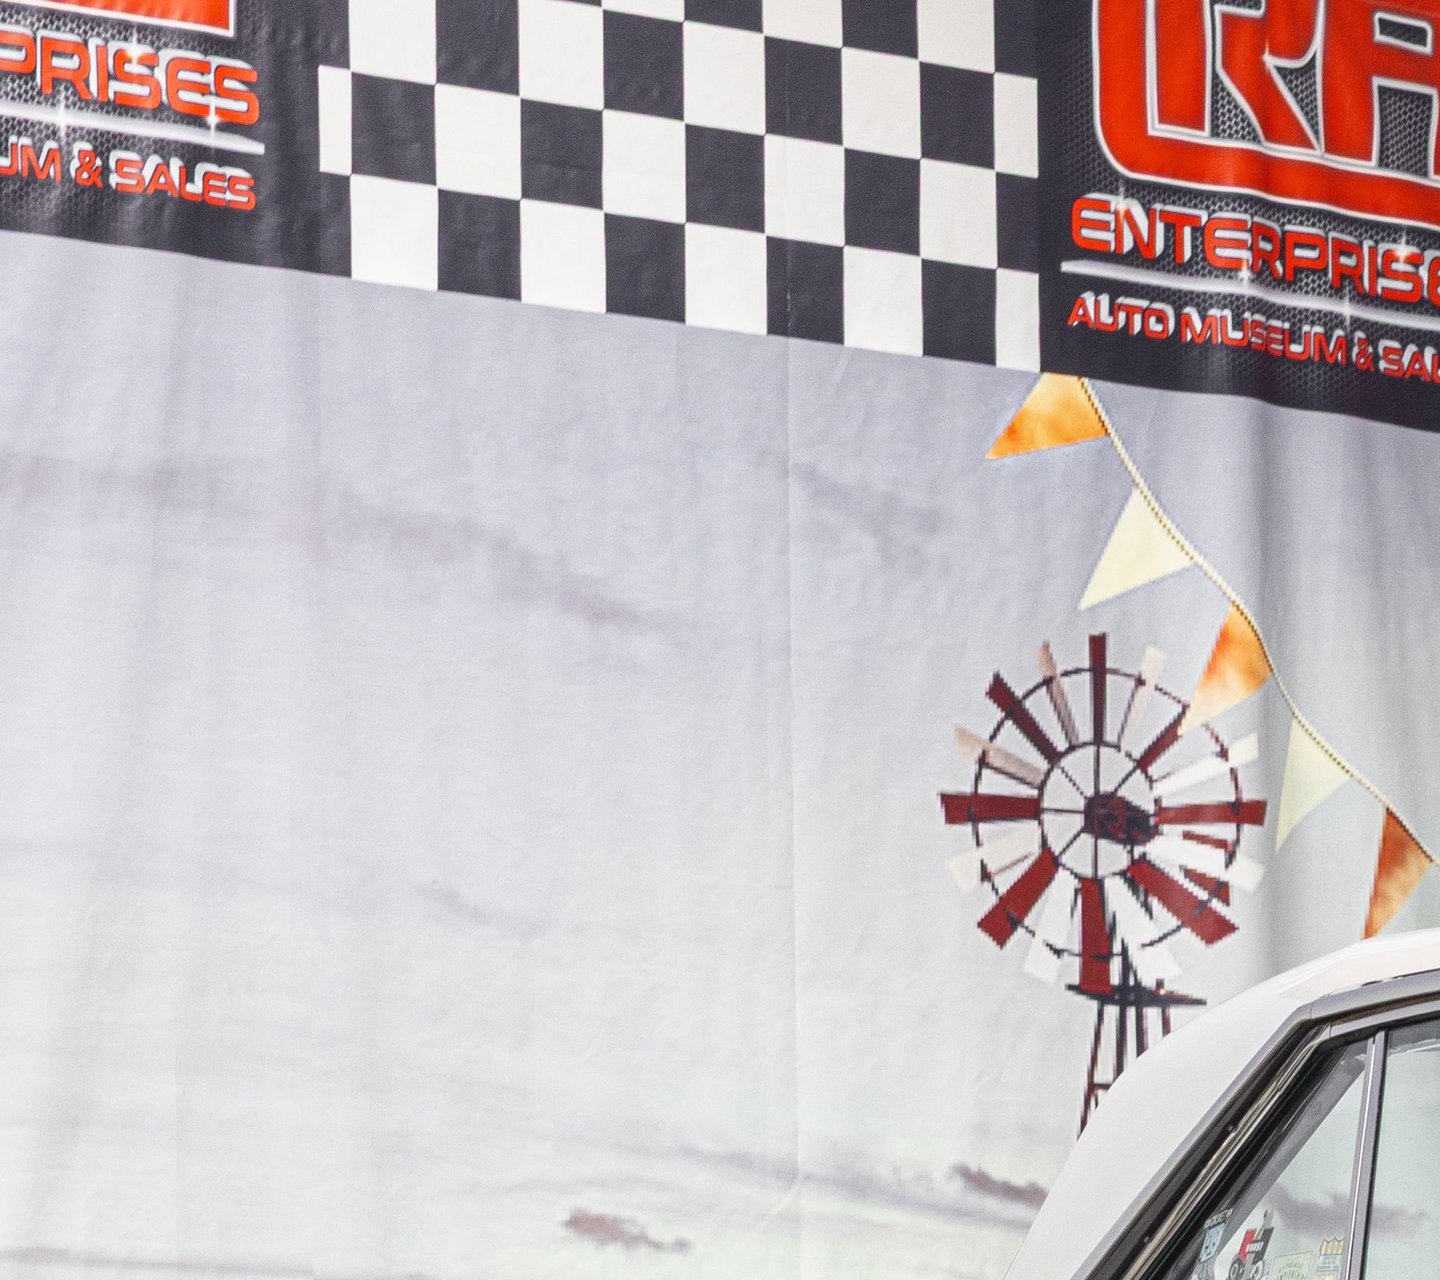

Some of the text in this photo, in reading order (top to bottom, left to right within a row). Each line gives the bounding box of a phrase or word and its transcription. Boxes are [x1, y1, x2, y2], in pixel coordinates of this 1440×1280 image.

[70, 141, 103, 188] &
[109, 150, 256, 211] SALES
[1067, 290, 1175, 343] AUTO
[1180, 309, 1348, 368] MUSEUM
[1351, 334, 1376, 371] &
